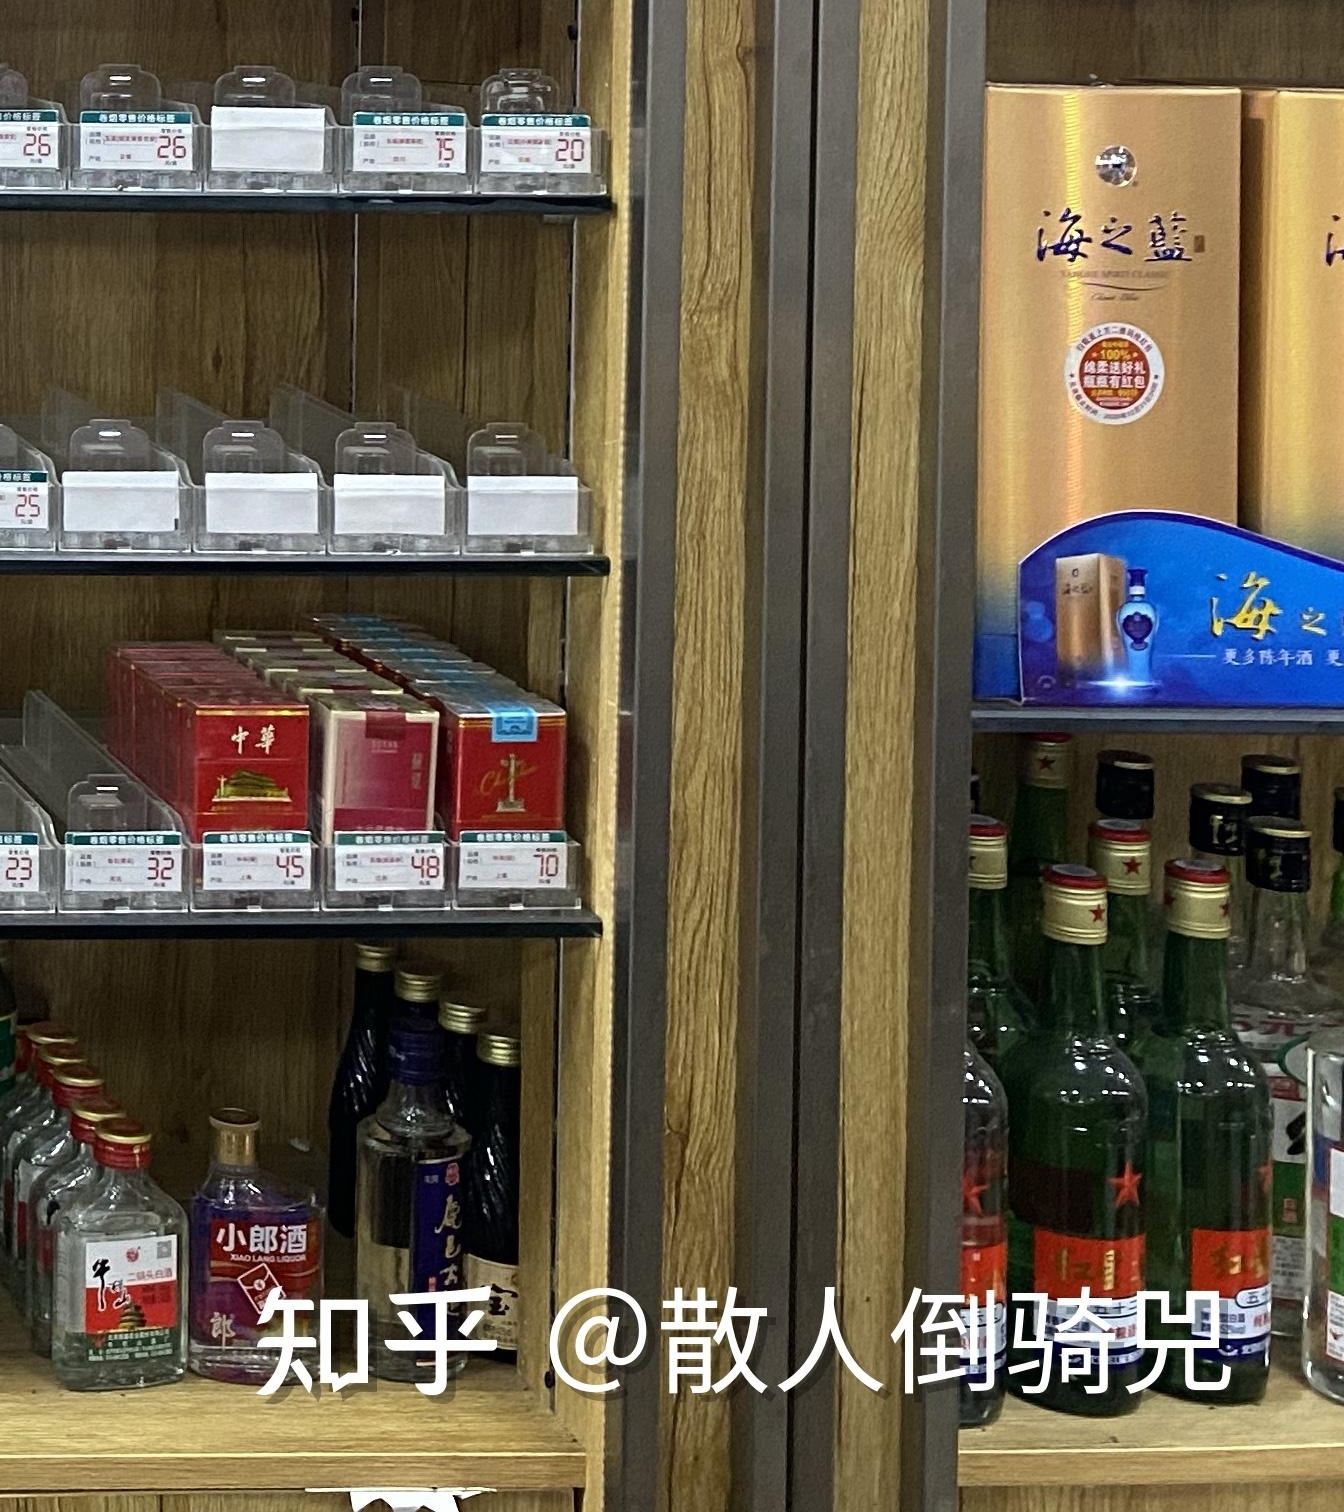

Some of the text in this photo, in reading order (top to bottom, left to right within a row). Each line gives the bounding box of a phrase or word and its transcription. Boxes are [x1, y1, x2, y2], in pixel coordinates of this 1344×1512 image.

[23, 133, 52, 157] 26
[555, 137, 585, 161] 20
[1100, 349, 1133, 361] 100%
[1083, 360, 1146, 375] 绵柔送好礼
[14, 494, 41, 519] 25
[1210, 570, 1328, 641] 海之
[1222, 648, 1314, 666] 更多陈年酒
[276, 856, 305, 880] 45
[411, 855, 440, 879] 48
[533, 854, 560, 878] 70
[216, 1222, 308, 1254] 小郎酒
[230, 1253, 307, 1262] XIAO LANG LIQUOR
